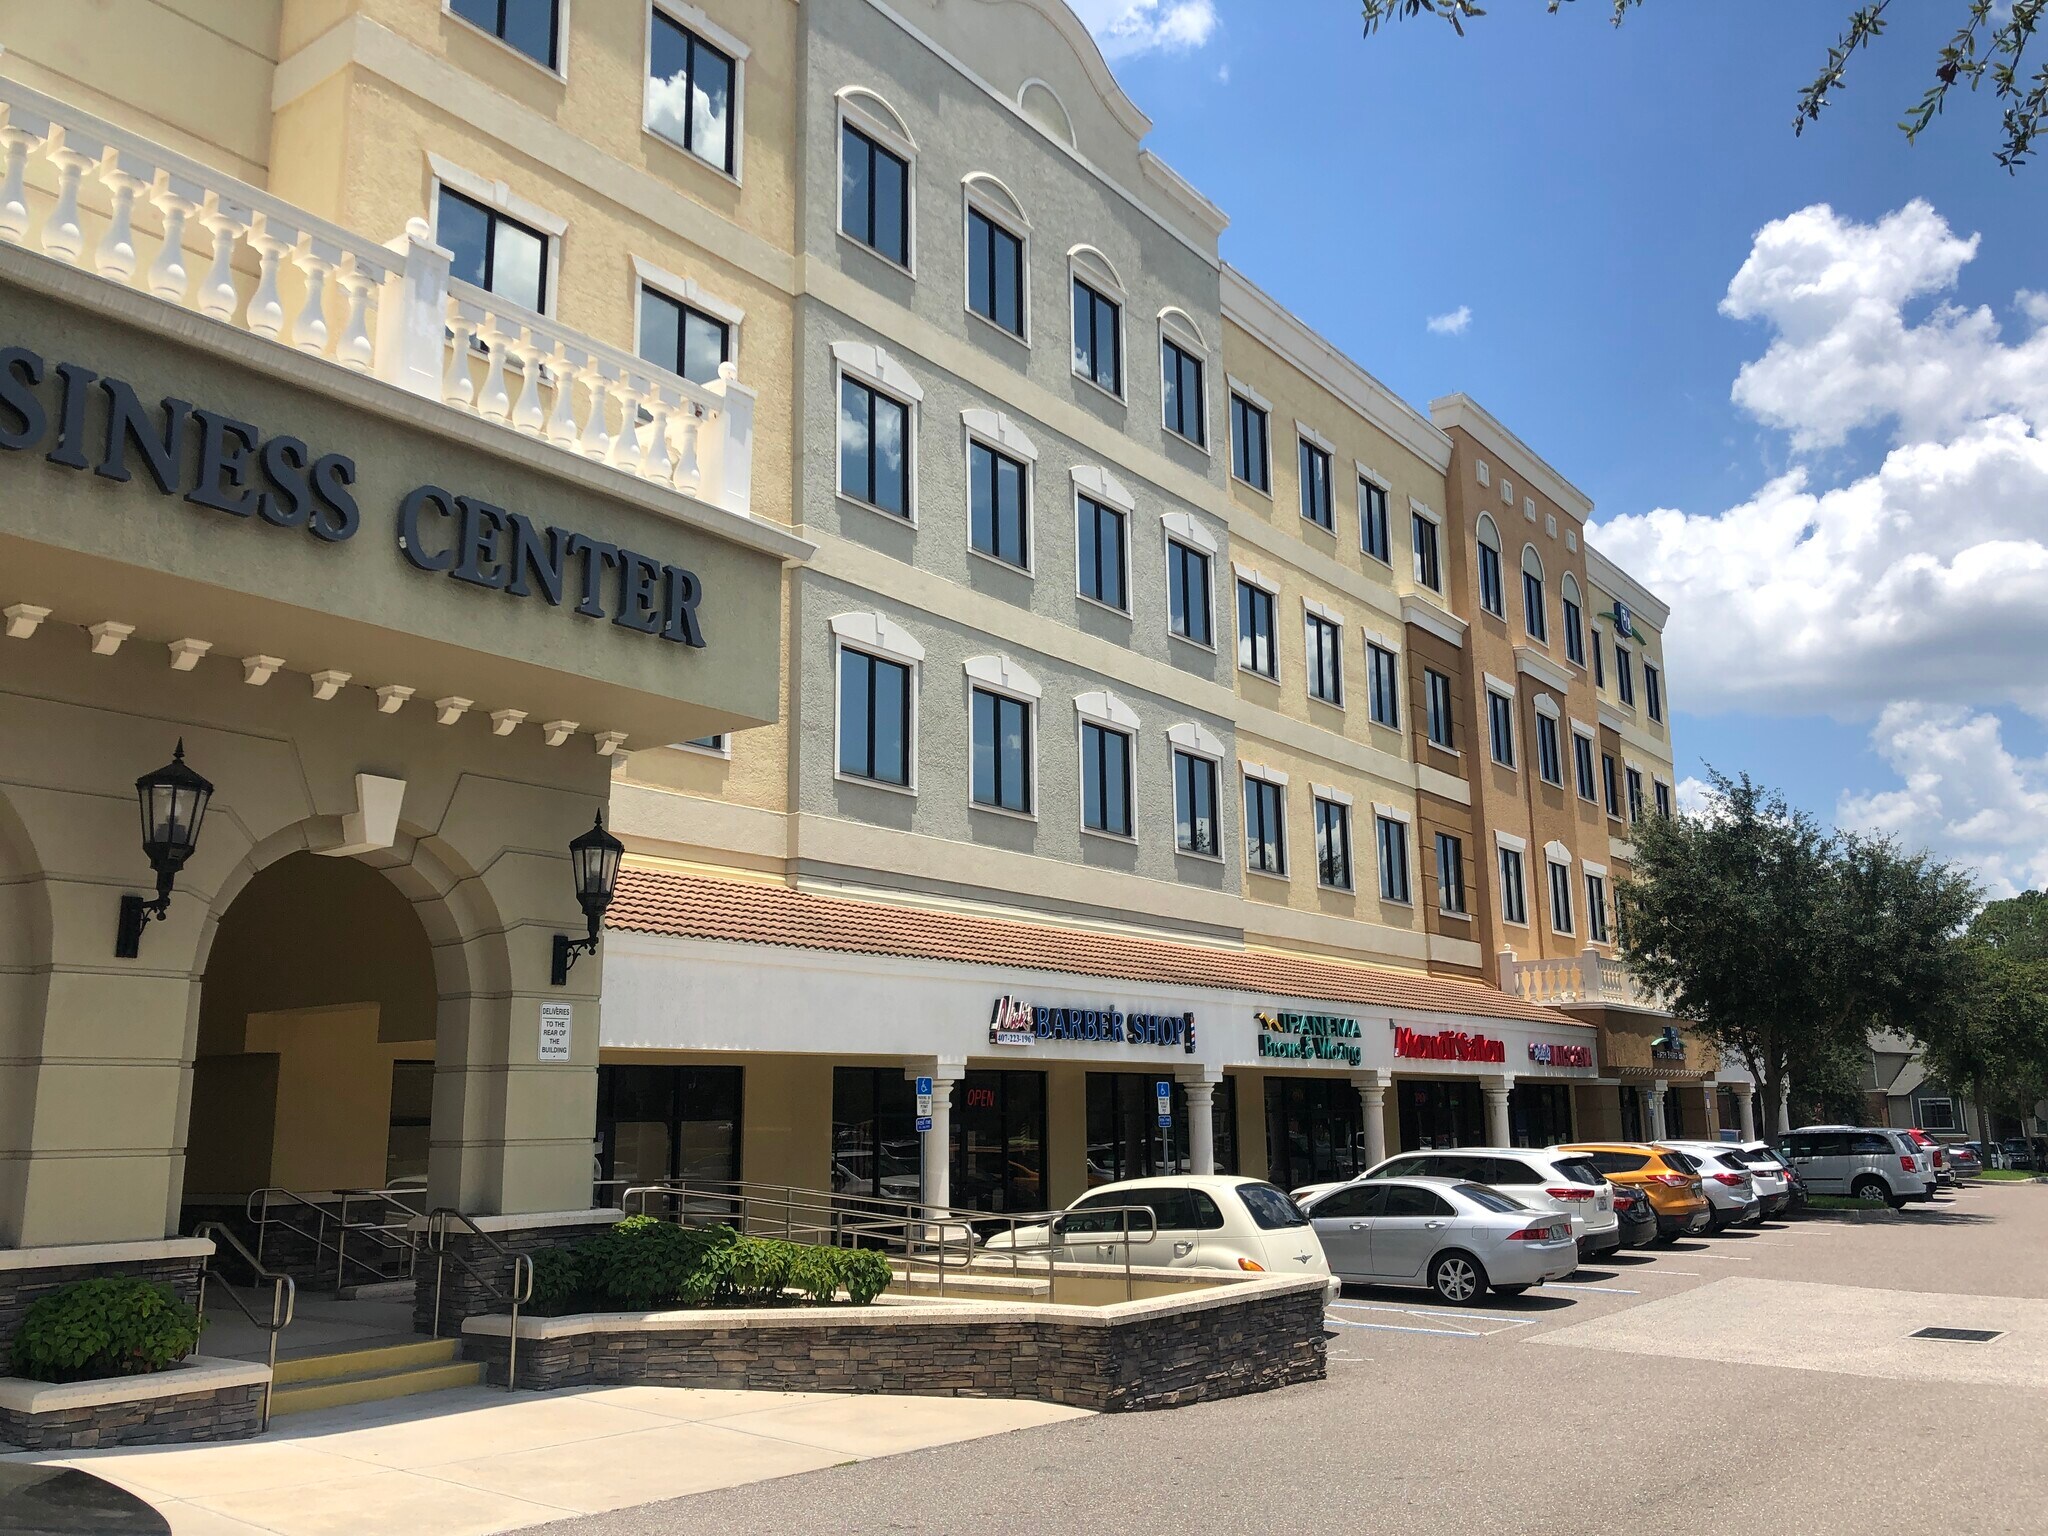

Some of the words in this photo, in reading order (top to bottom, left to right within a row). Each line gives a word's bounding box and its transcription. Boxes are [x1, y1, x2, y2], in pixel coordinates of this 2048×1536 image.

[398, 484, 707, 649] CENTER
[542, 1007, 570, 1015] DELIVERIES
[1035, 1007, 1125, 1043] BARBER
[1129, 1013, 1186, 1046] SHOP
[1280, 1013, 1362, 1038] IPANEMA
[1262, 1034, 1301, 1058] Brows
[1316, 1037, 1362, 1066] Waxing
[967, 1088, 995, 1108] OPEN
